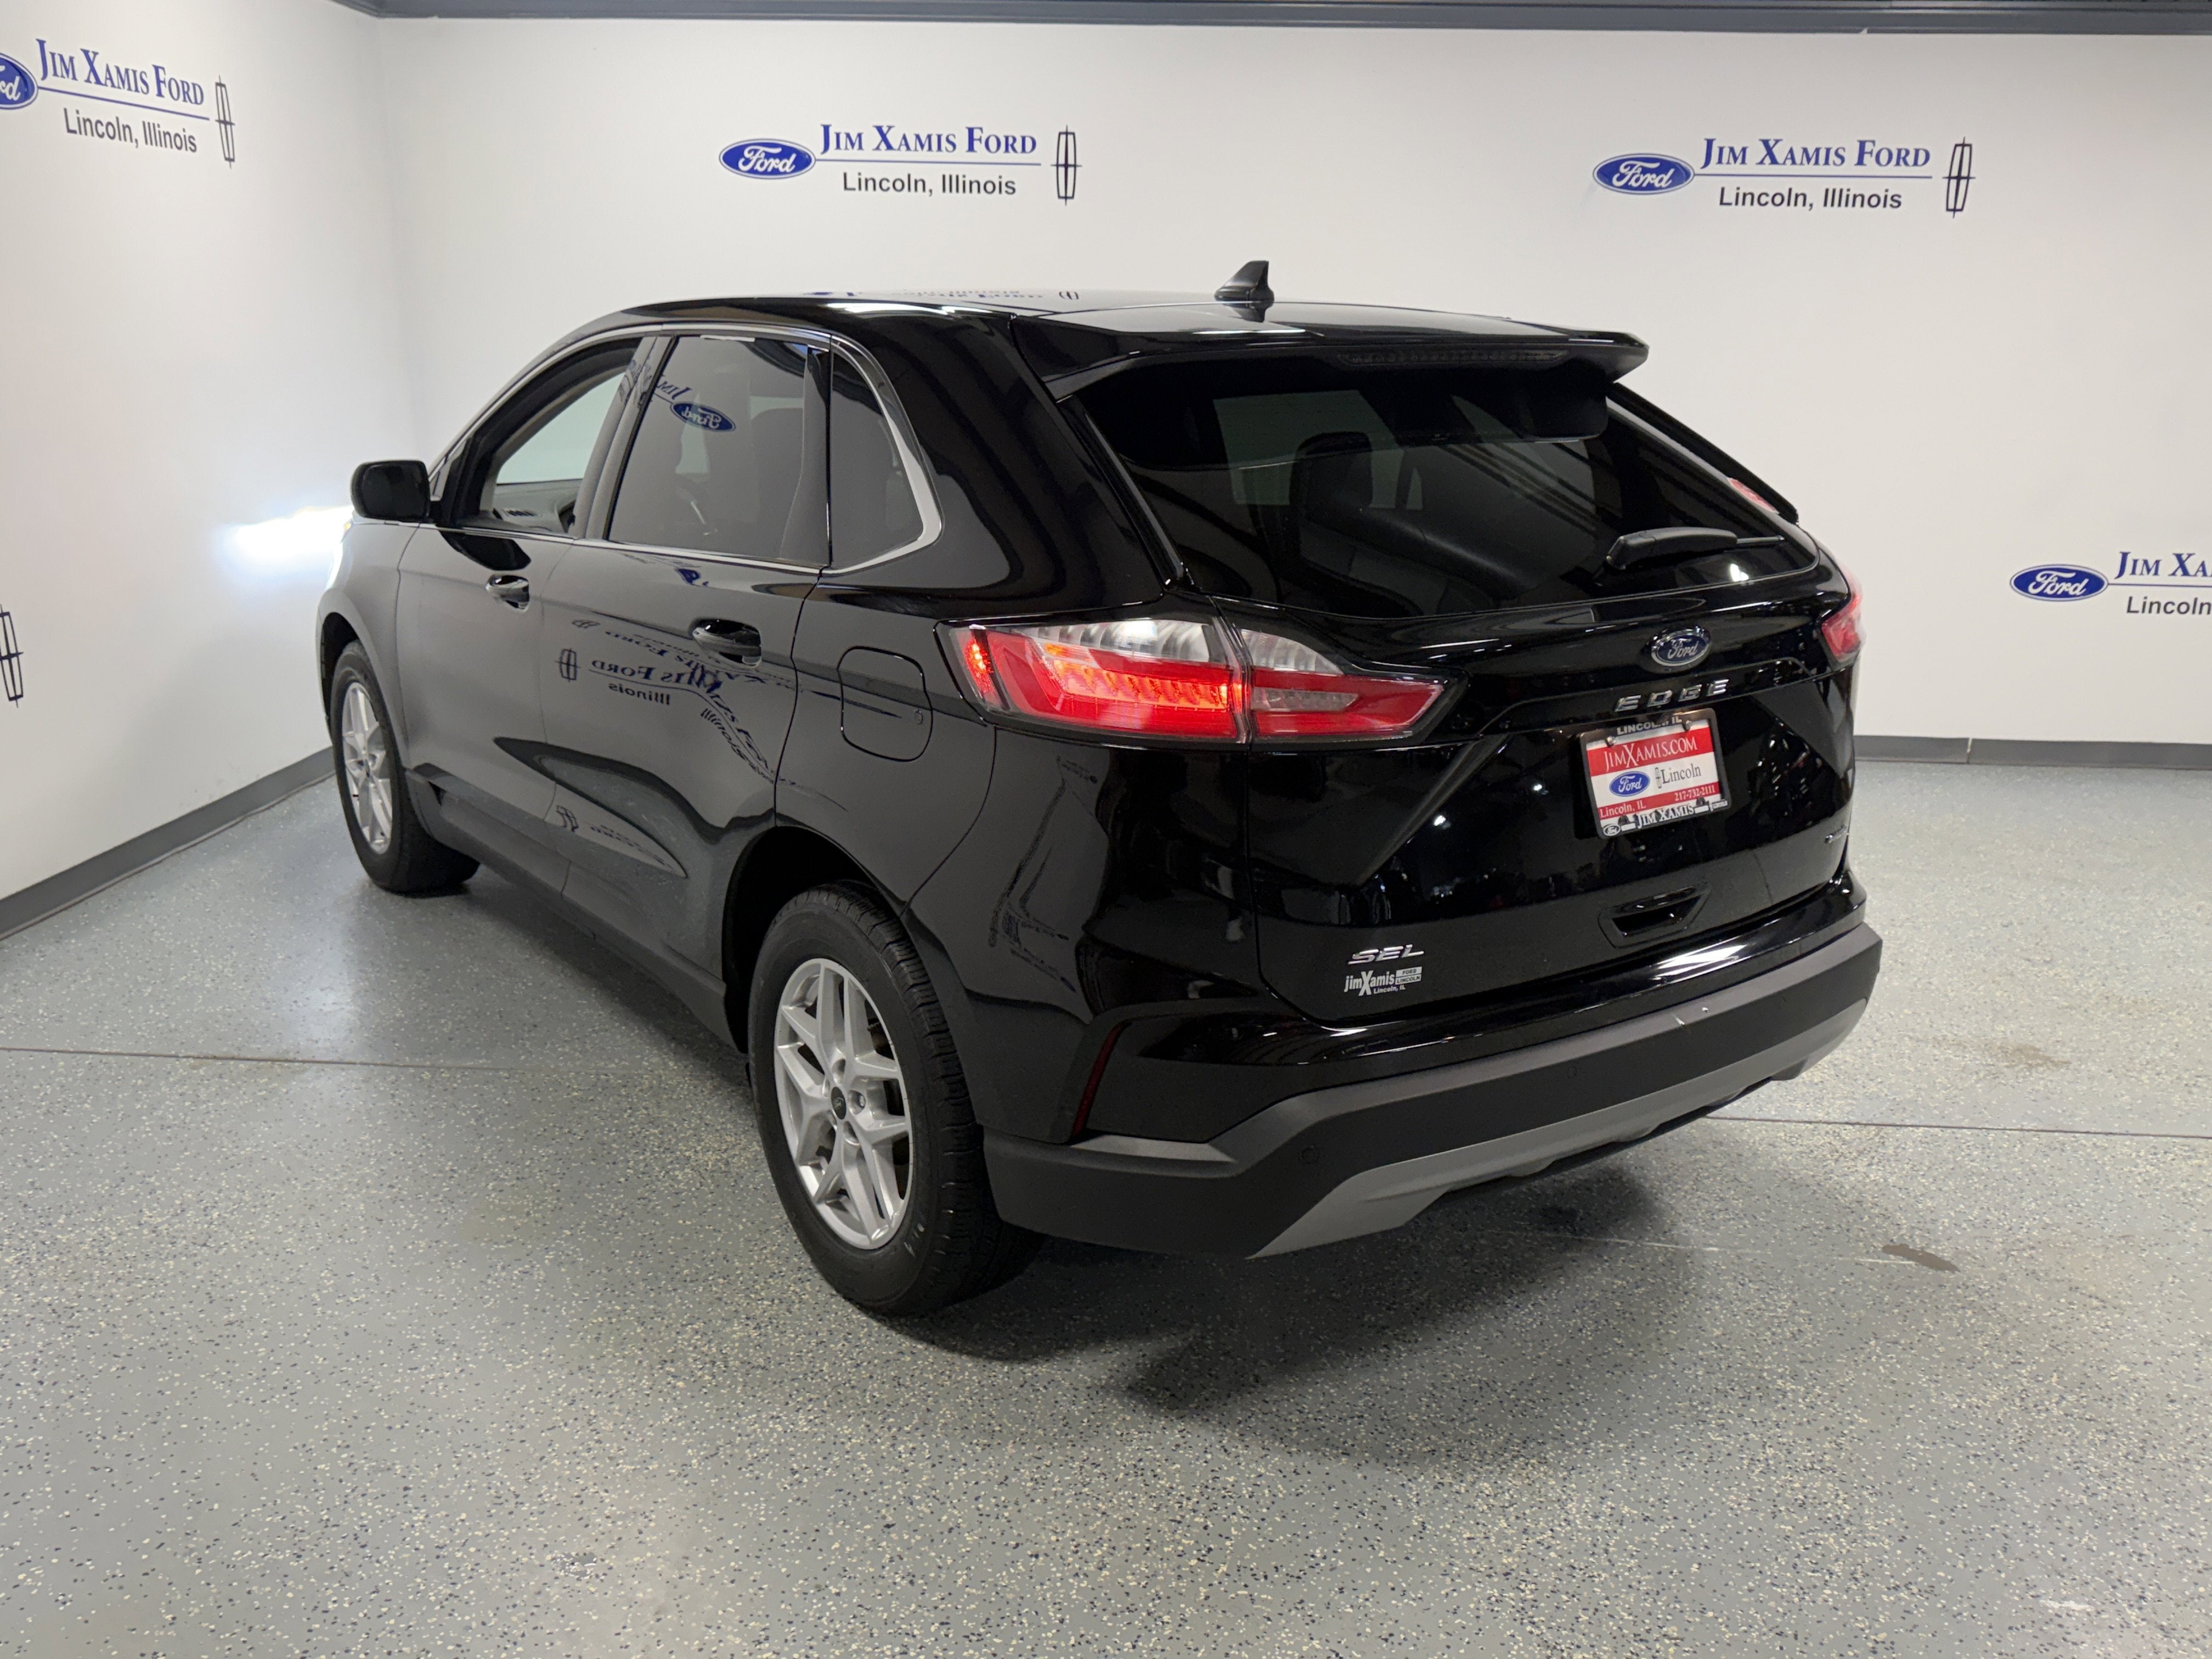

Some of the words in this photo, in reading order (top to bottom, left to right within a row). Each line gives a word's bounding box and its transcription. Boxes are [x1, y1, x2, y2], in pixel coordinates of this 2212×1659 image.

[36, 38, 78, 81] JIM
[80, 48, 149, 94] XAMIS
[152, 64, 204, 105] FORD
[64, 108, 139, 148] Lincoln,
[143, 121, 197, 153] Illinois
[820, 124, 864, 155] JIM
[872, 125, 957, 154] XAMIS
[966, 127, 1037, 154] FORD
[738, 145, 796, 174] Ford
[1700, 138, 1749, 169] JIM
[1756, 139, 1846, 167] XAMIS
[1854, 140, 1931, 167] FORD
[843, 172, 933, 196] Lincoln,
[941, 174, 1016, 195] Illinois
[1612, 160, 1672, 188] Ford
[1719, 187, 1814, 210] Lincoln,
[1823, 188, 1902, 209] Illinois
[2114, 551, 2162, 579] JIM
[2168, 553, 2212, 577] XA
[2028, 570, 2089, 595] Ford
[2126, 596, 2212, 615] Lincoln
[1668, 638, 1699, 659] Ford
[1614, 679, 1729, 712] EDGE
[1618, 775, 1642, 793] Ford
[1661, 763, 1701, 784] Lincoln
[1599, 804, 1635, 818] Lincoln,
[1637, 800, 1646, 810] IL
[1635, 813, 1657, 829] JIM
[1658, 805, 1694, 822] XAMIS
[1347, 944, 1424, 965] SEL
[1374, 985, 1398, 994] Lincoln,
[1397, 975, 1420, 984] LINCOLN
